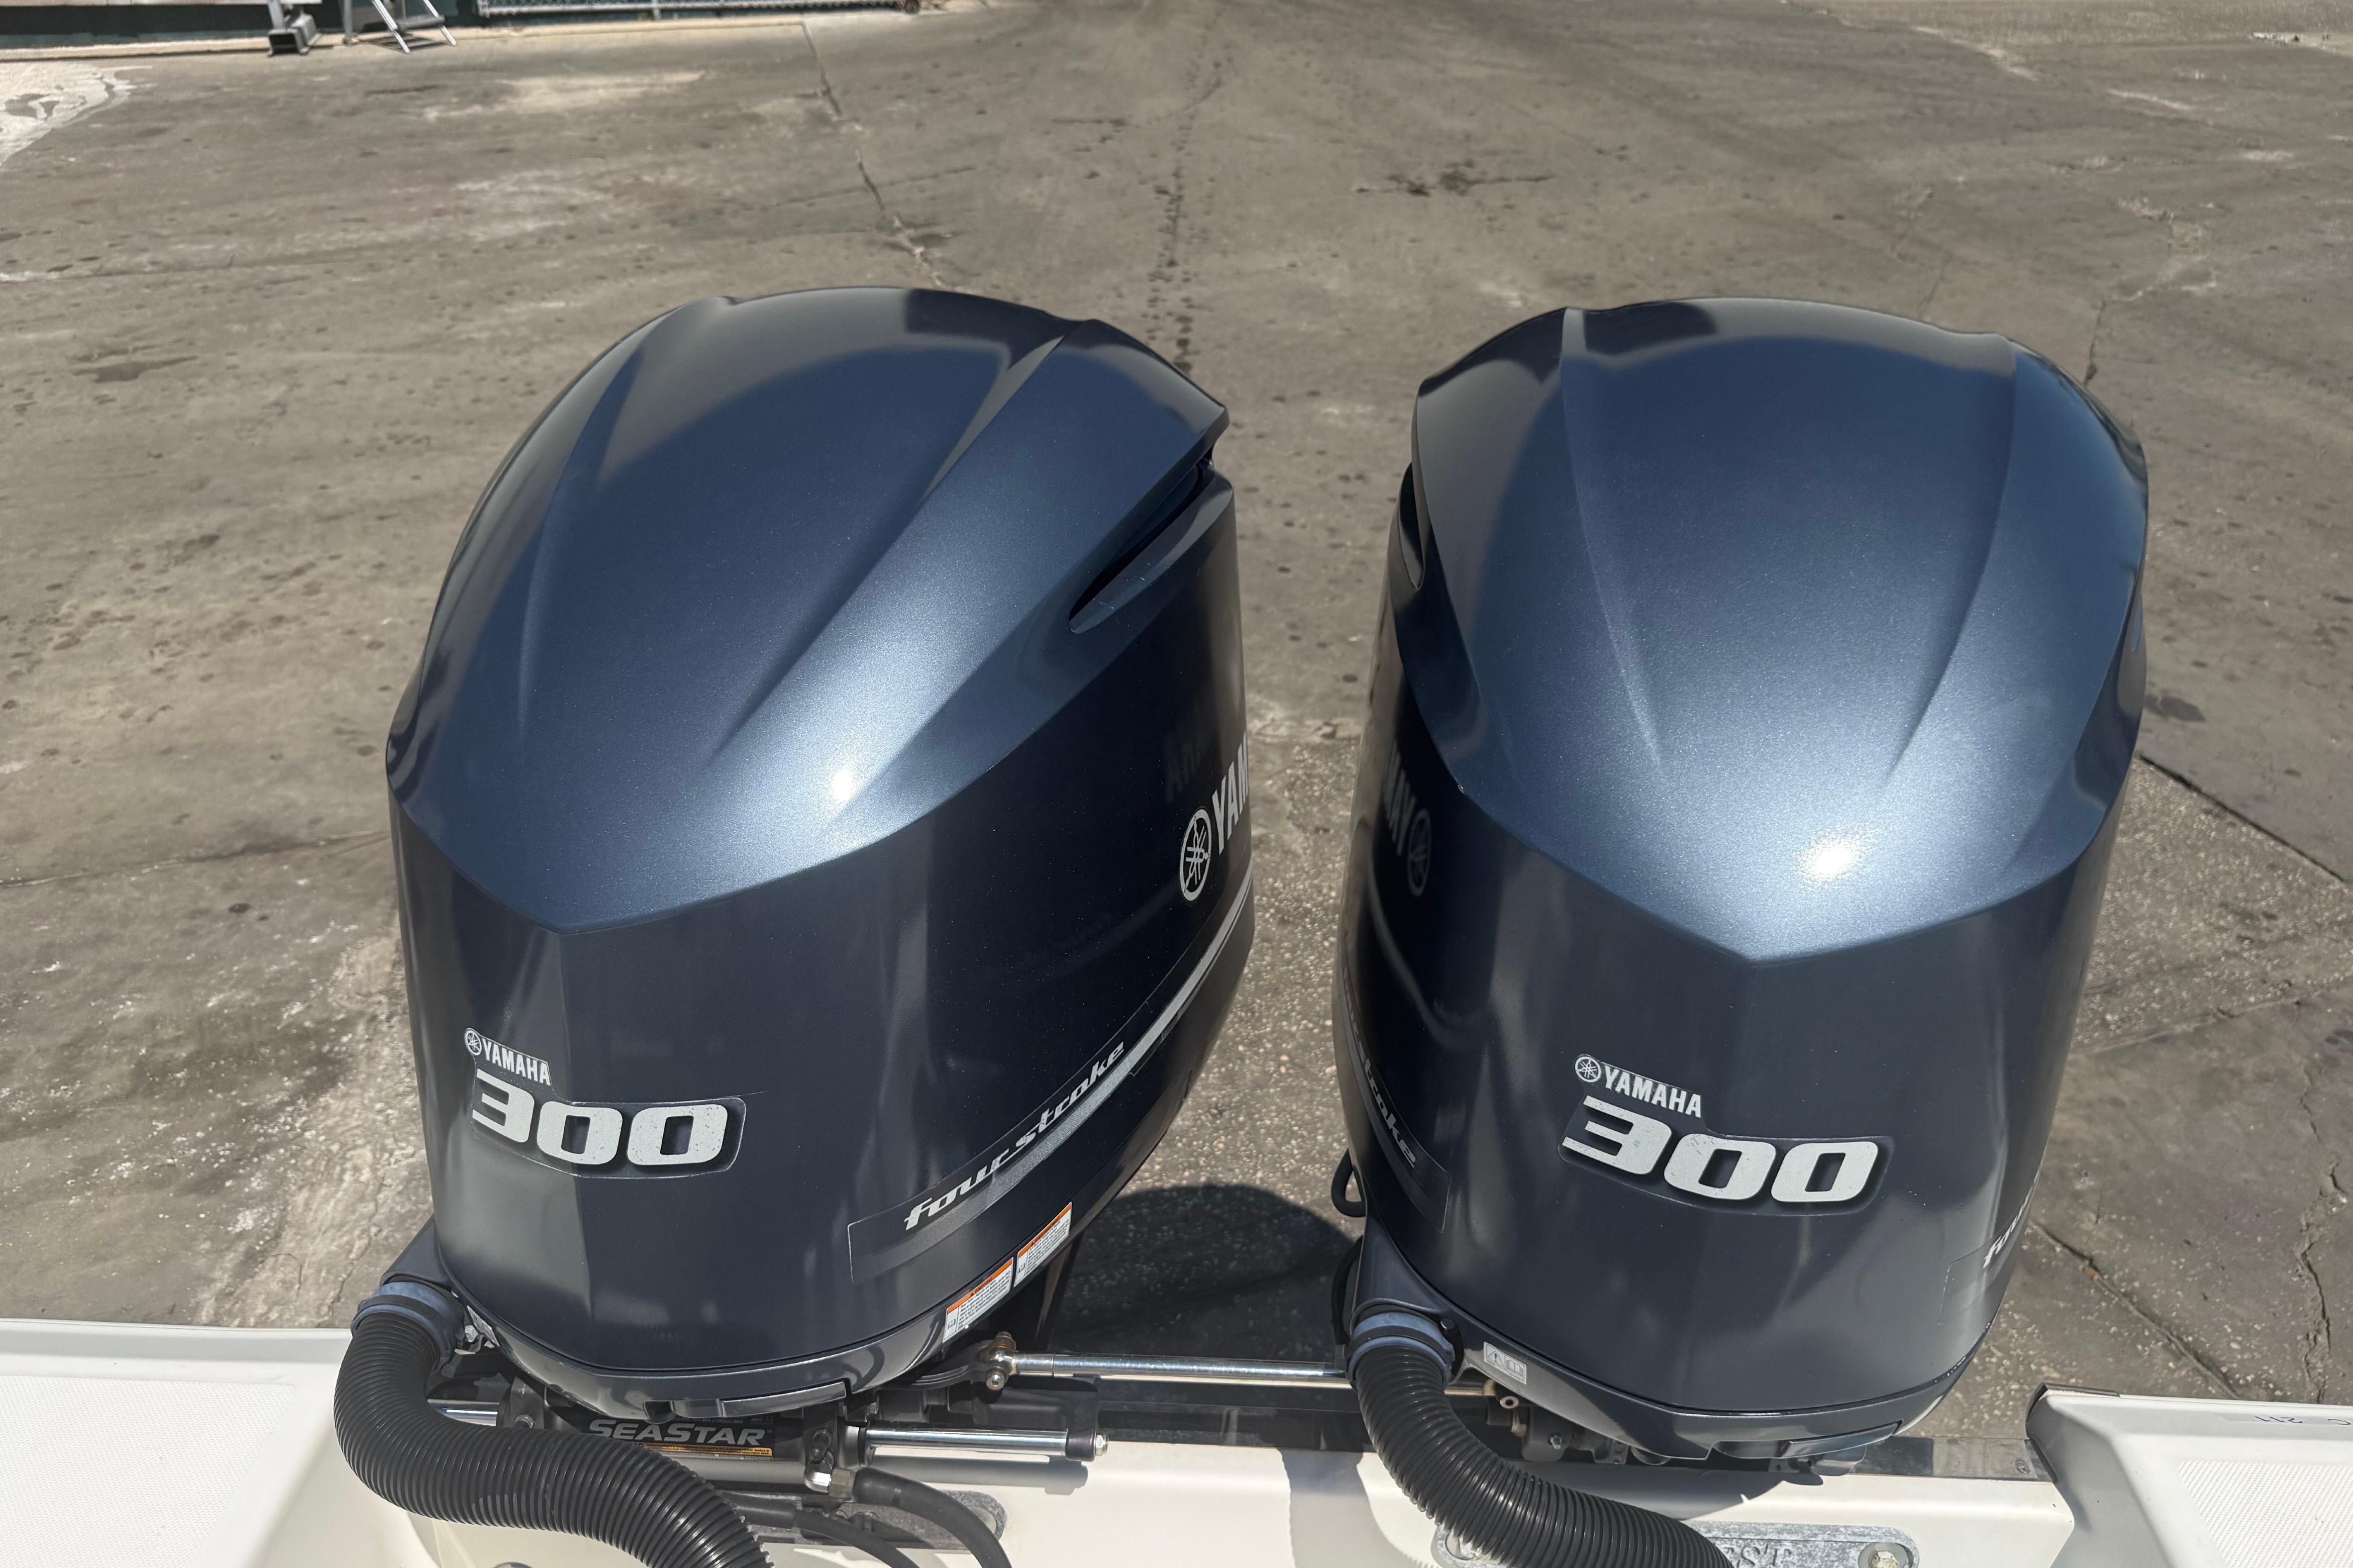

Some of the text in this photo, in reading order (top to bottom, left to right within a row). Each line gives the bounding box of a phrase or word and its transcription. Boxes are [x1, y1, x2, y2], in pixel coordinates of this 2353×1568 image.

[483, 1038, 551, 1085] YAMAHA
[472, 1069, 728, 1165] 300
[1604, 1066, 1701, 1118] YAMAHA
[1562, 1095, 1878, 1202] 300
[589, 1419, 766, 1445] SEASTAR
